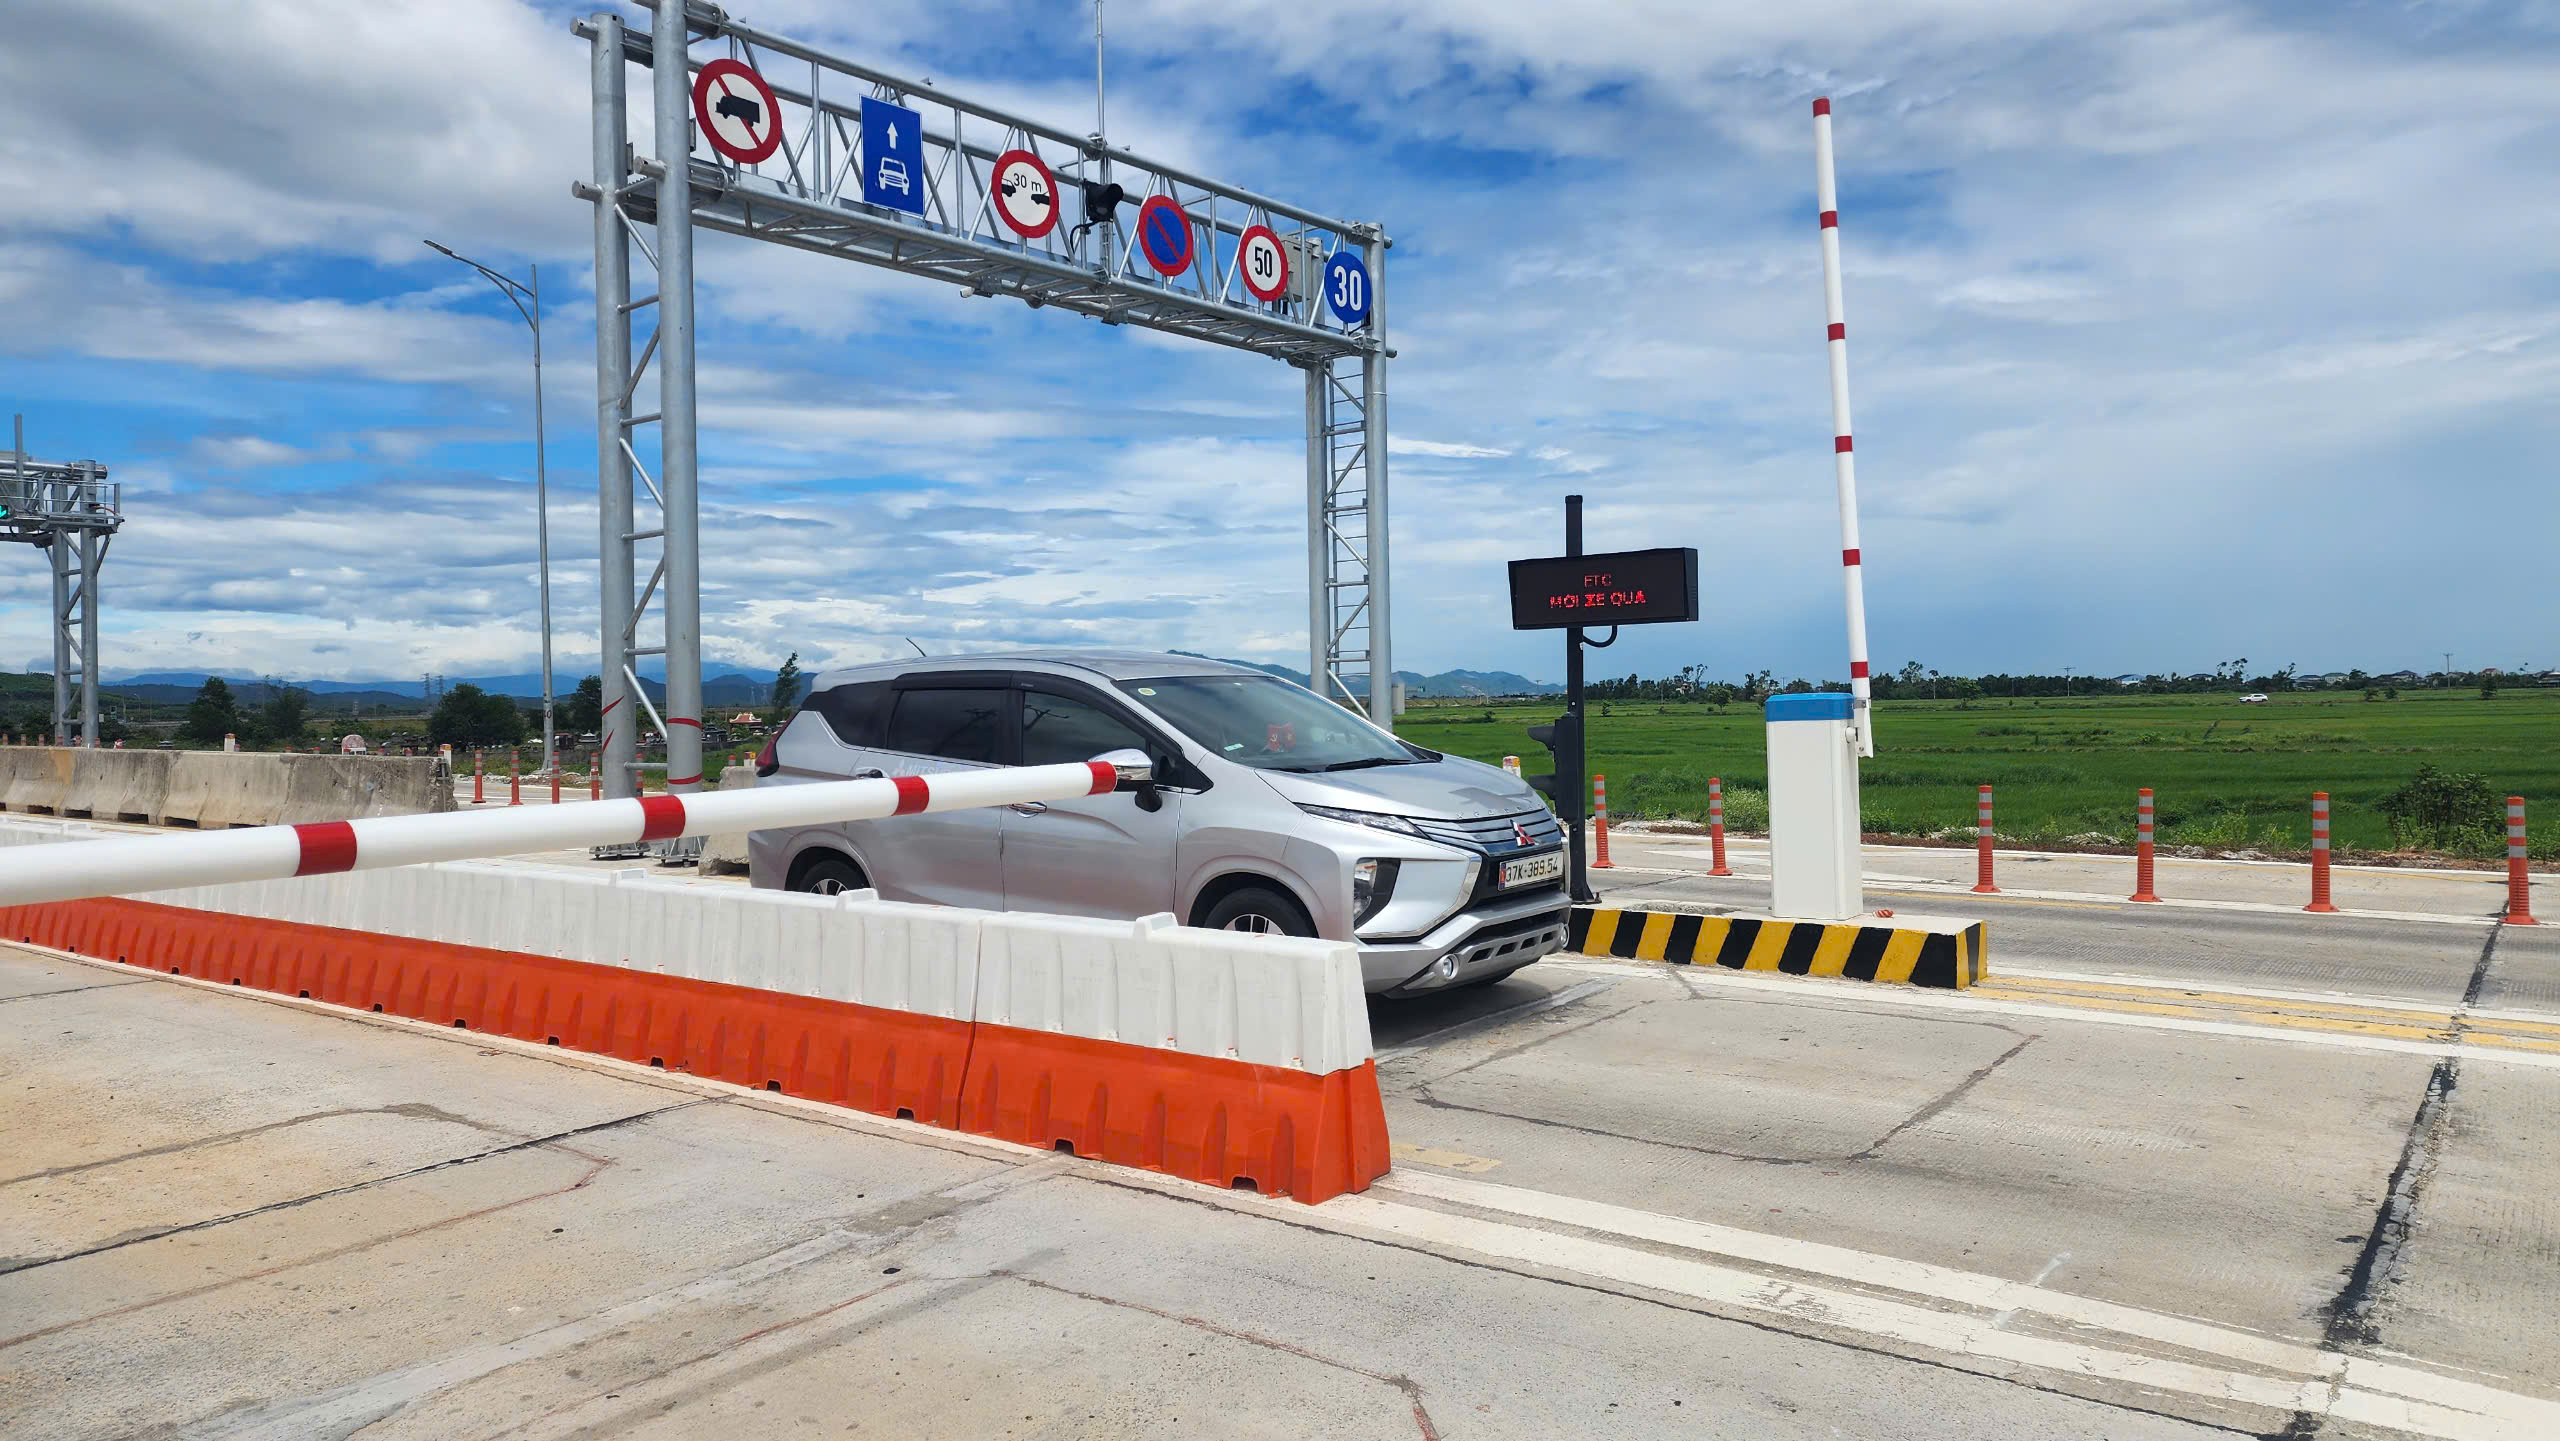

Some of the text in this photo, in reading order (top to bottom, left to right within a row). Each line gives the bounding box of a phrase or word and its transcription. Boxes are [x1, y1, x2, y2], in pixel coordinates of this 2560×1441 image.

[1013, 173, 1042, 192] 30 m
[1254, 246, 1273, 278] 50
[1334, 265, 1362, 311] 30
[1610, 589, 1647, 607] QUA
